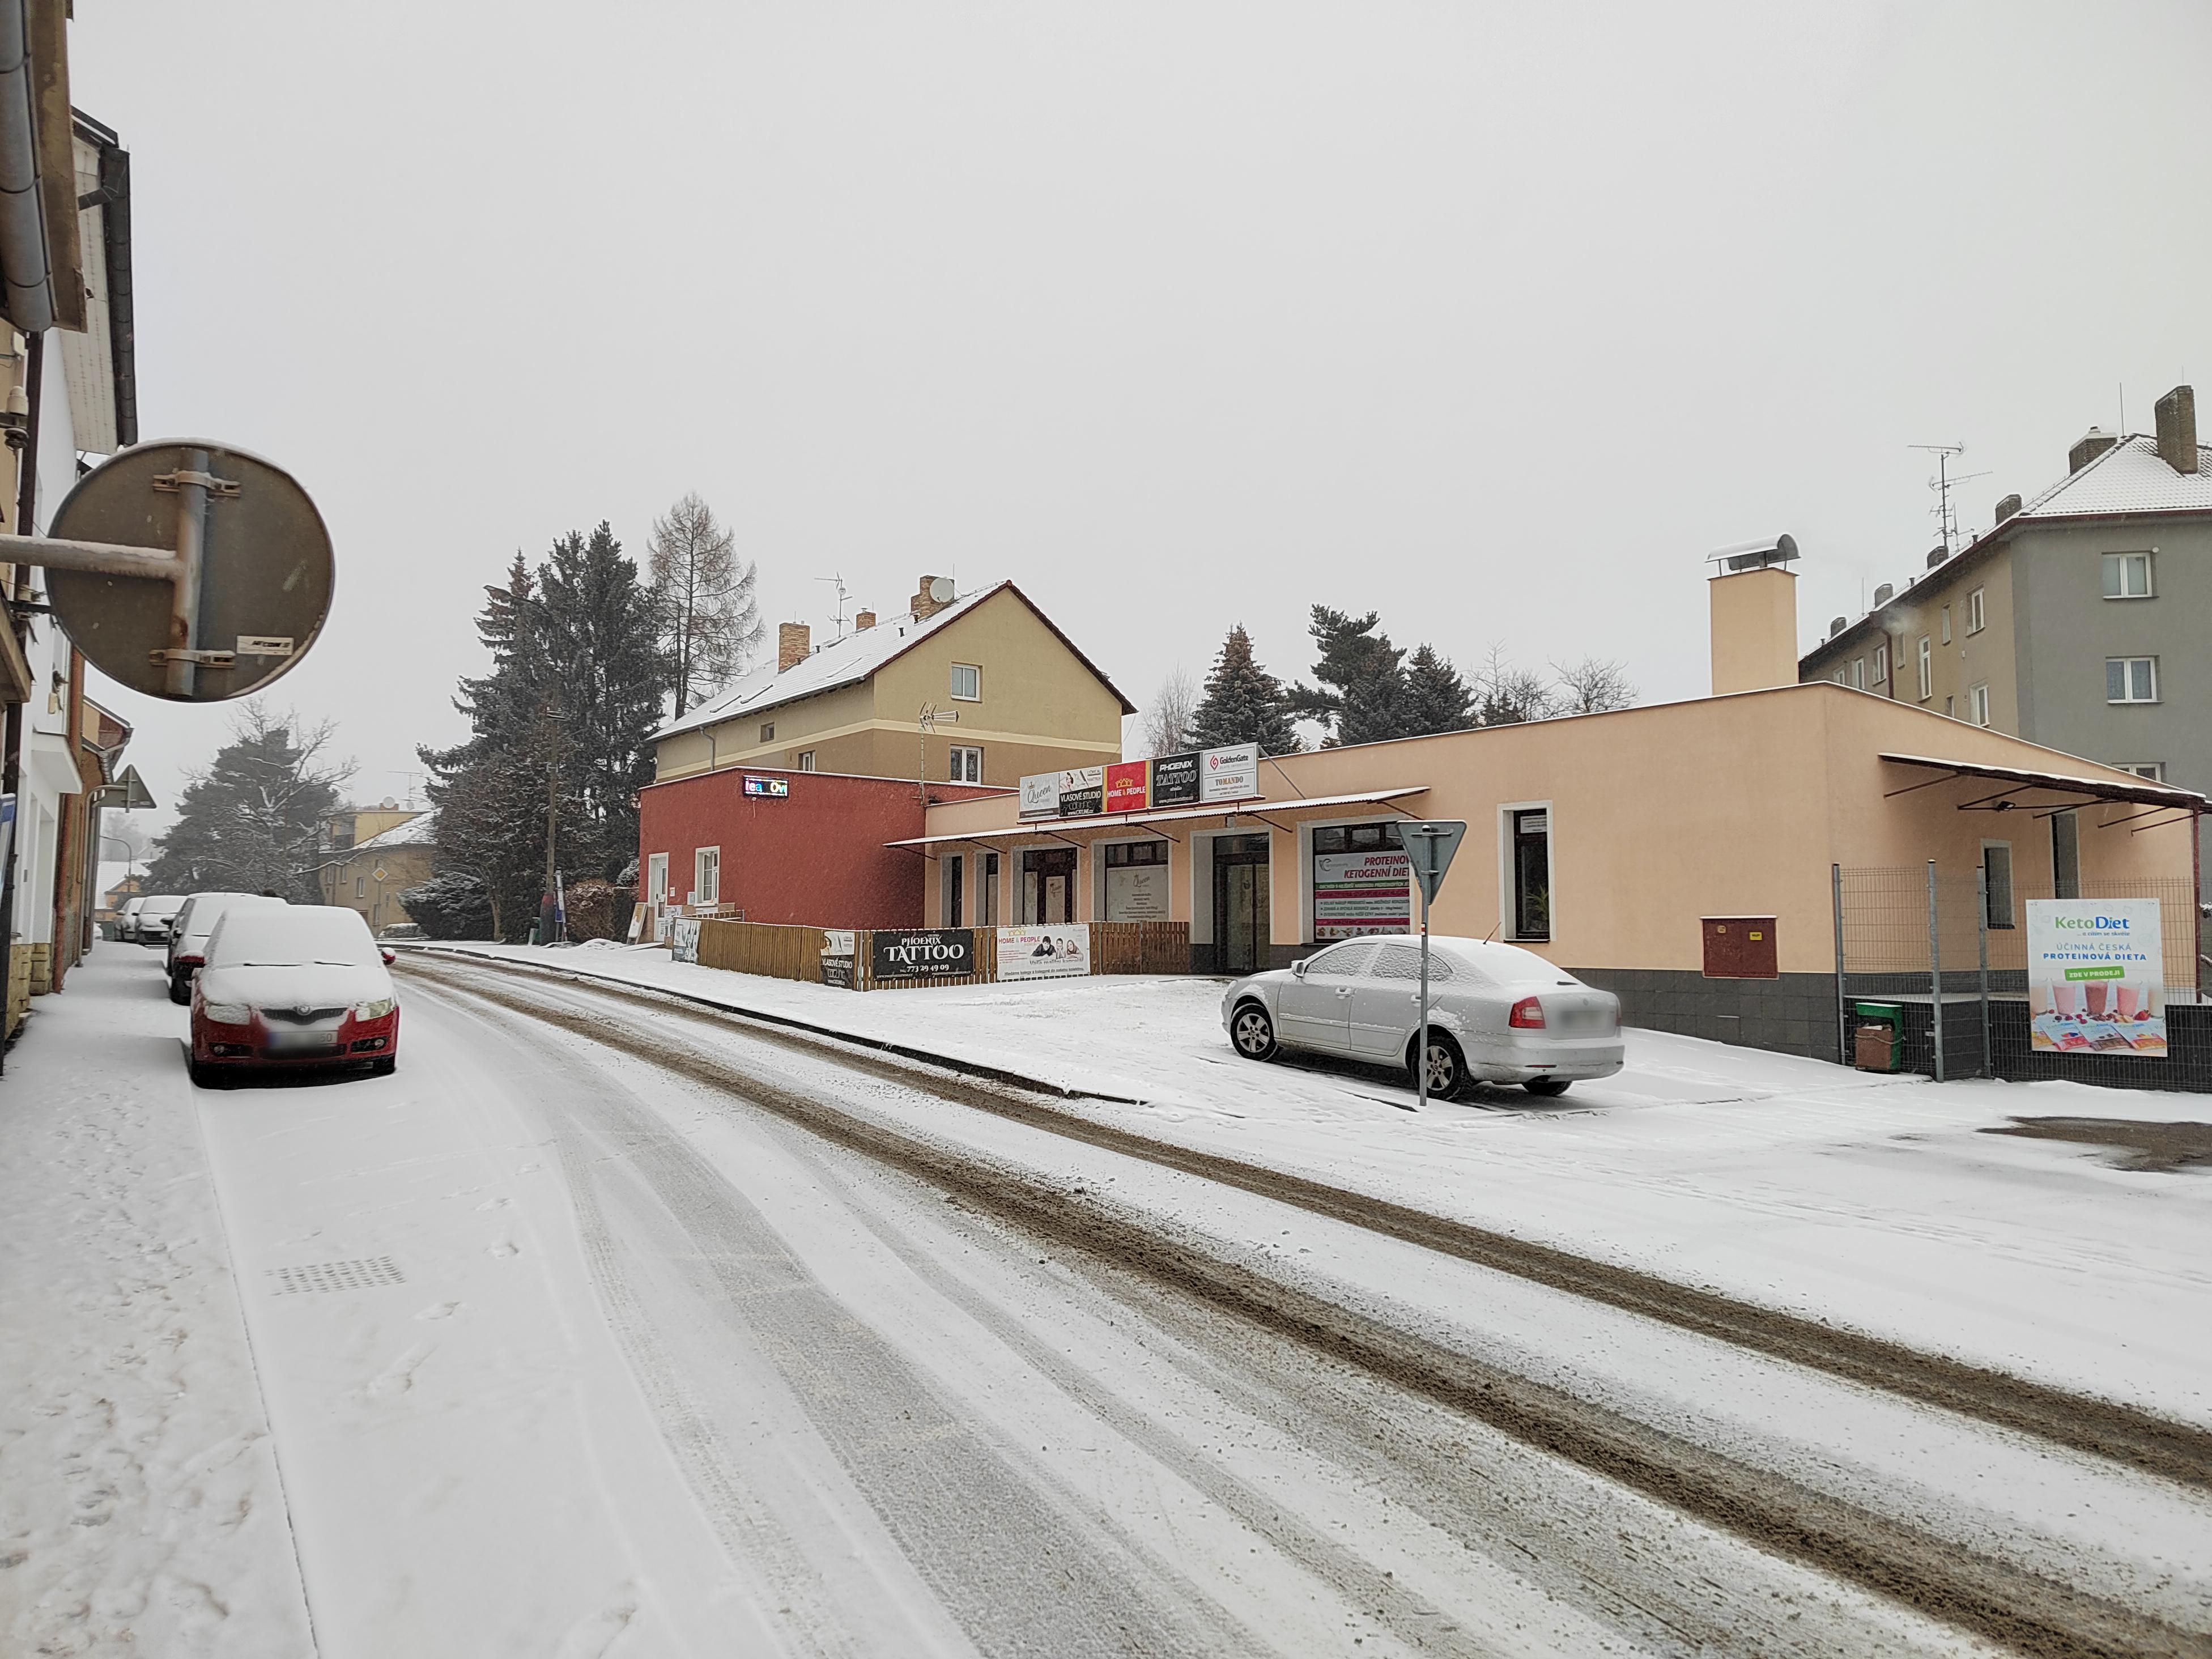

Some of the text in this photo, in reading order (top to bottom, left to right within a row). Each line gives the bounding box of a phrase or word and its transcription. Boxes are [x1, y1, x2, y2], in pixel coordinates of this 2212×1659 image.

[1220, 755, 1249, 764] GoldenGate
[1159, 760, 1193, 772] PHOENIX
[1156, 770, 1197, 786] TATTOO
[1215, 776, 1244, 786] TOMANDO
[1028, 785, 1052, 803] Queen
[1060, 790, 1101, 802] VLASOVÉ STUDIO
[1107, 789, 1122, 798] HOME
[1126, 786, 1146, 796] PEOPLE
[1344, 866, 1392, 878] KETOGENNÍ
[2055, 916, 2130, 929] KetoDiet
[901, 936, 942, 947] PHOENIX
[2056, 942, 2132, 951] ÚČINNÁ ČESKÁ
[883, 945, 964, 964] TATTOO
[822, 956, 838, 967] VLASOVÉ
